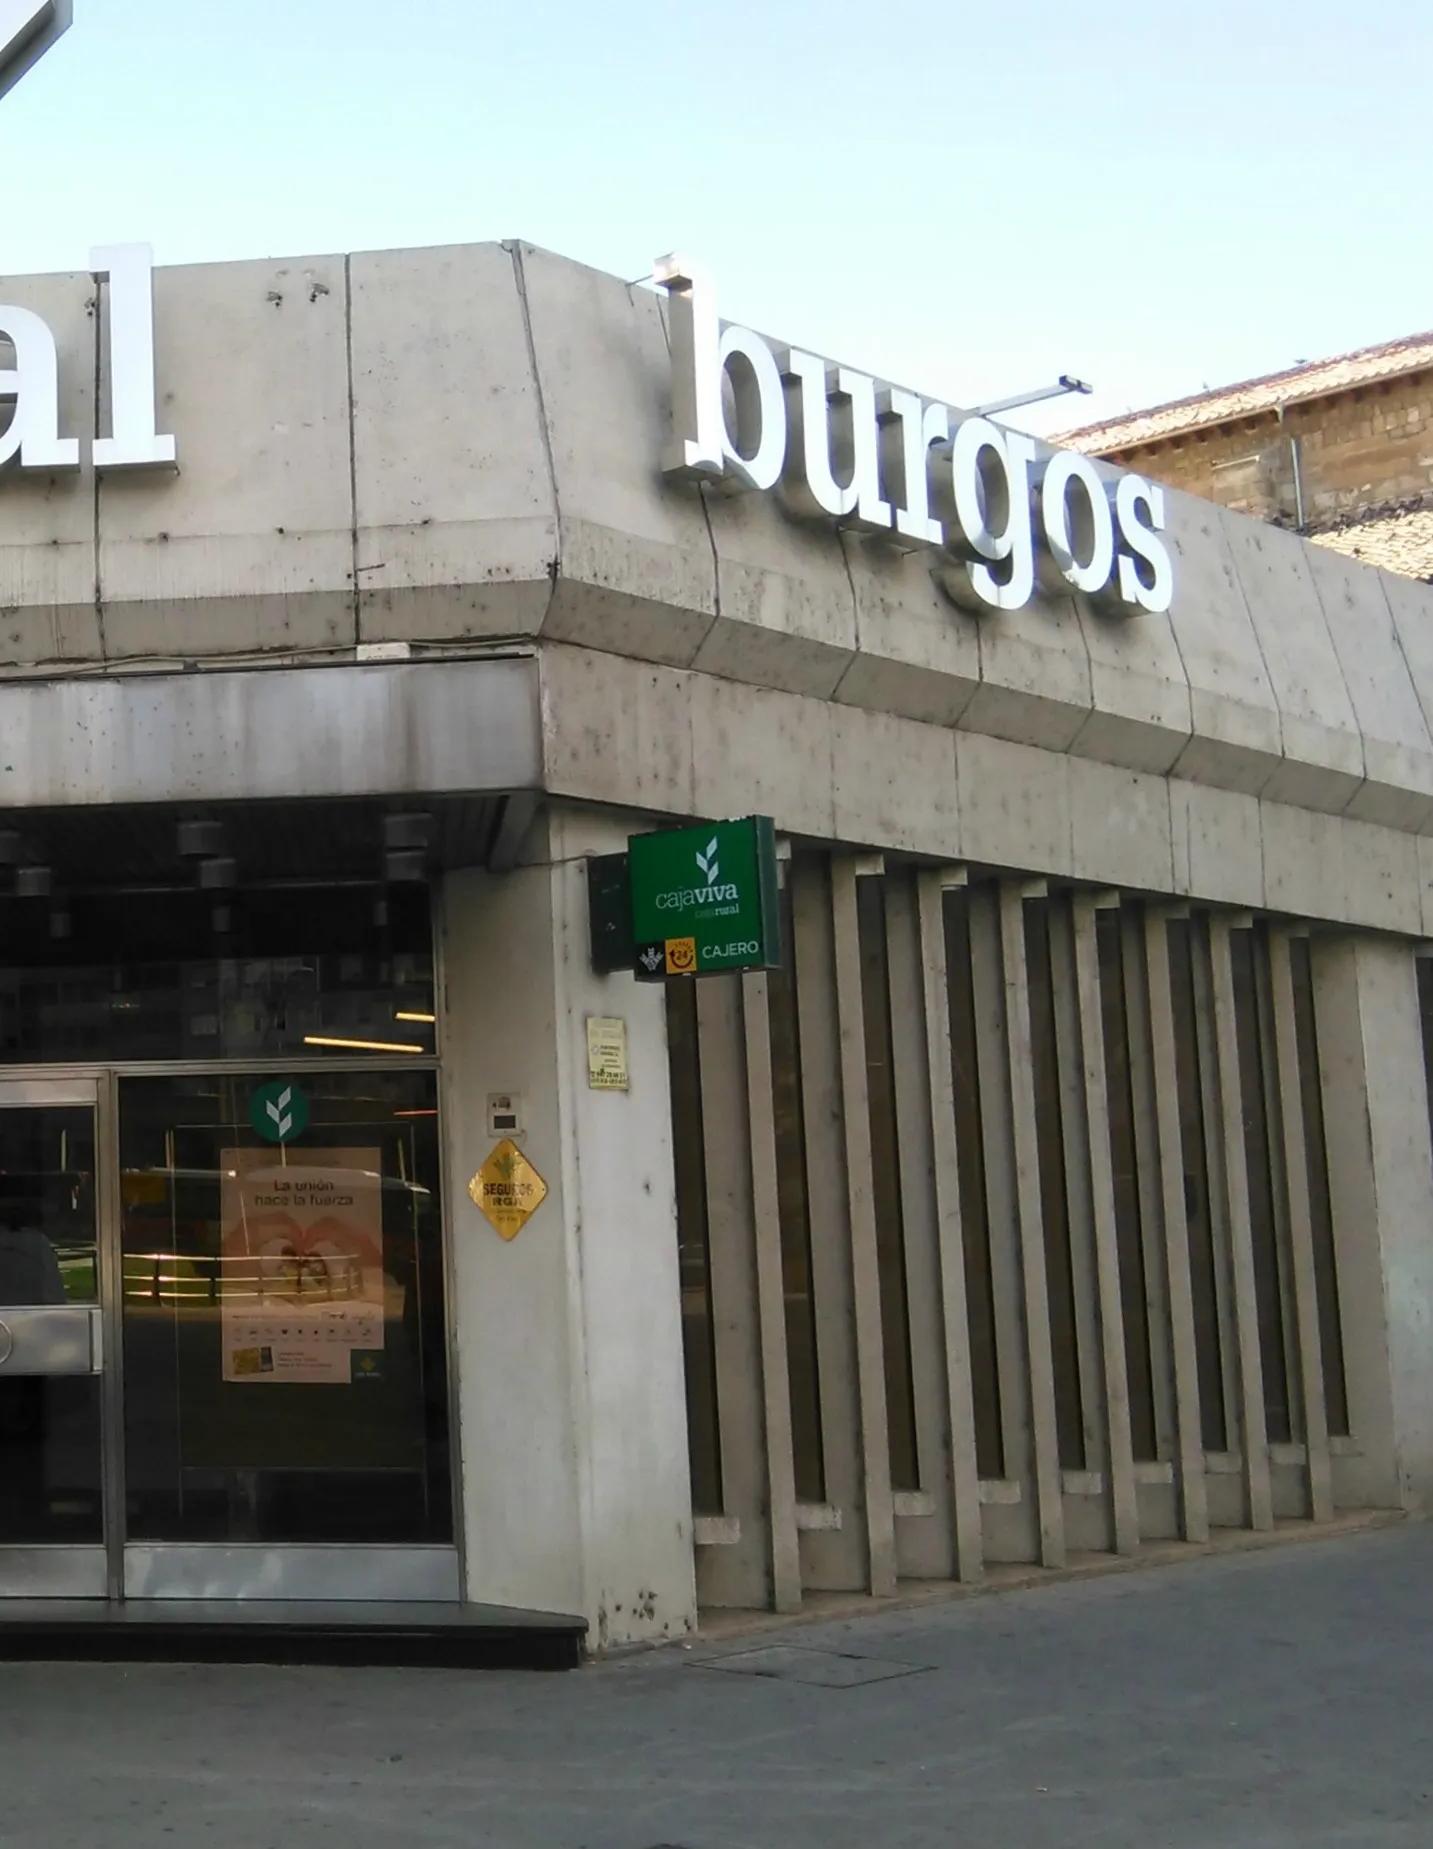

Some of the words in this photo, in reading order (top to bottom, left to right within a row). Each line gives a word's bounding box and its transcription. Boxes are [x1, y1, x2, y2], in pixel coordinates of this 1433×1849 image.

[655, 252, 1173, 612] burgos
[655, 883, 739, 912] cajaviva
[702, 941, 759, 959] CAJERO
[274, 1180, 291, 1192] La
[483, 1183, 534, 1197] SEGUROS
